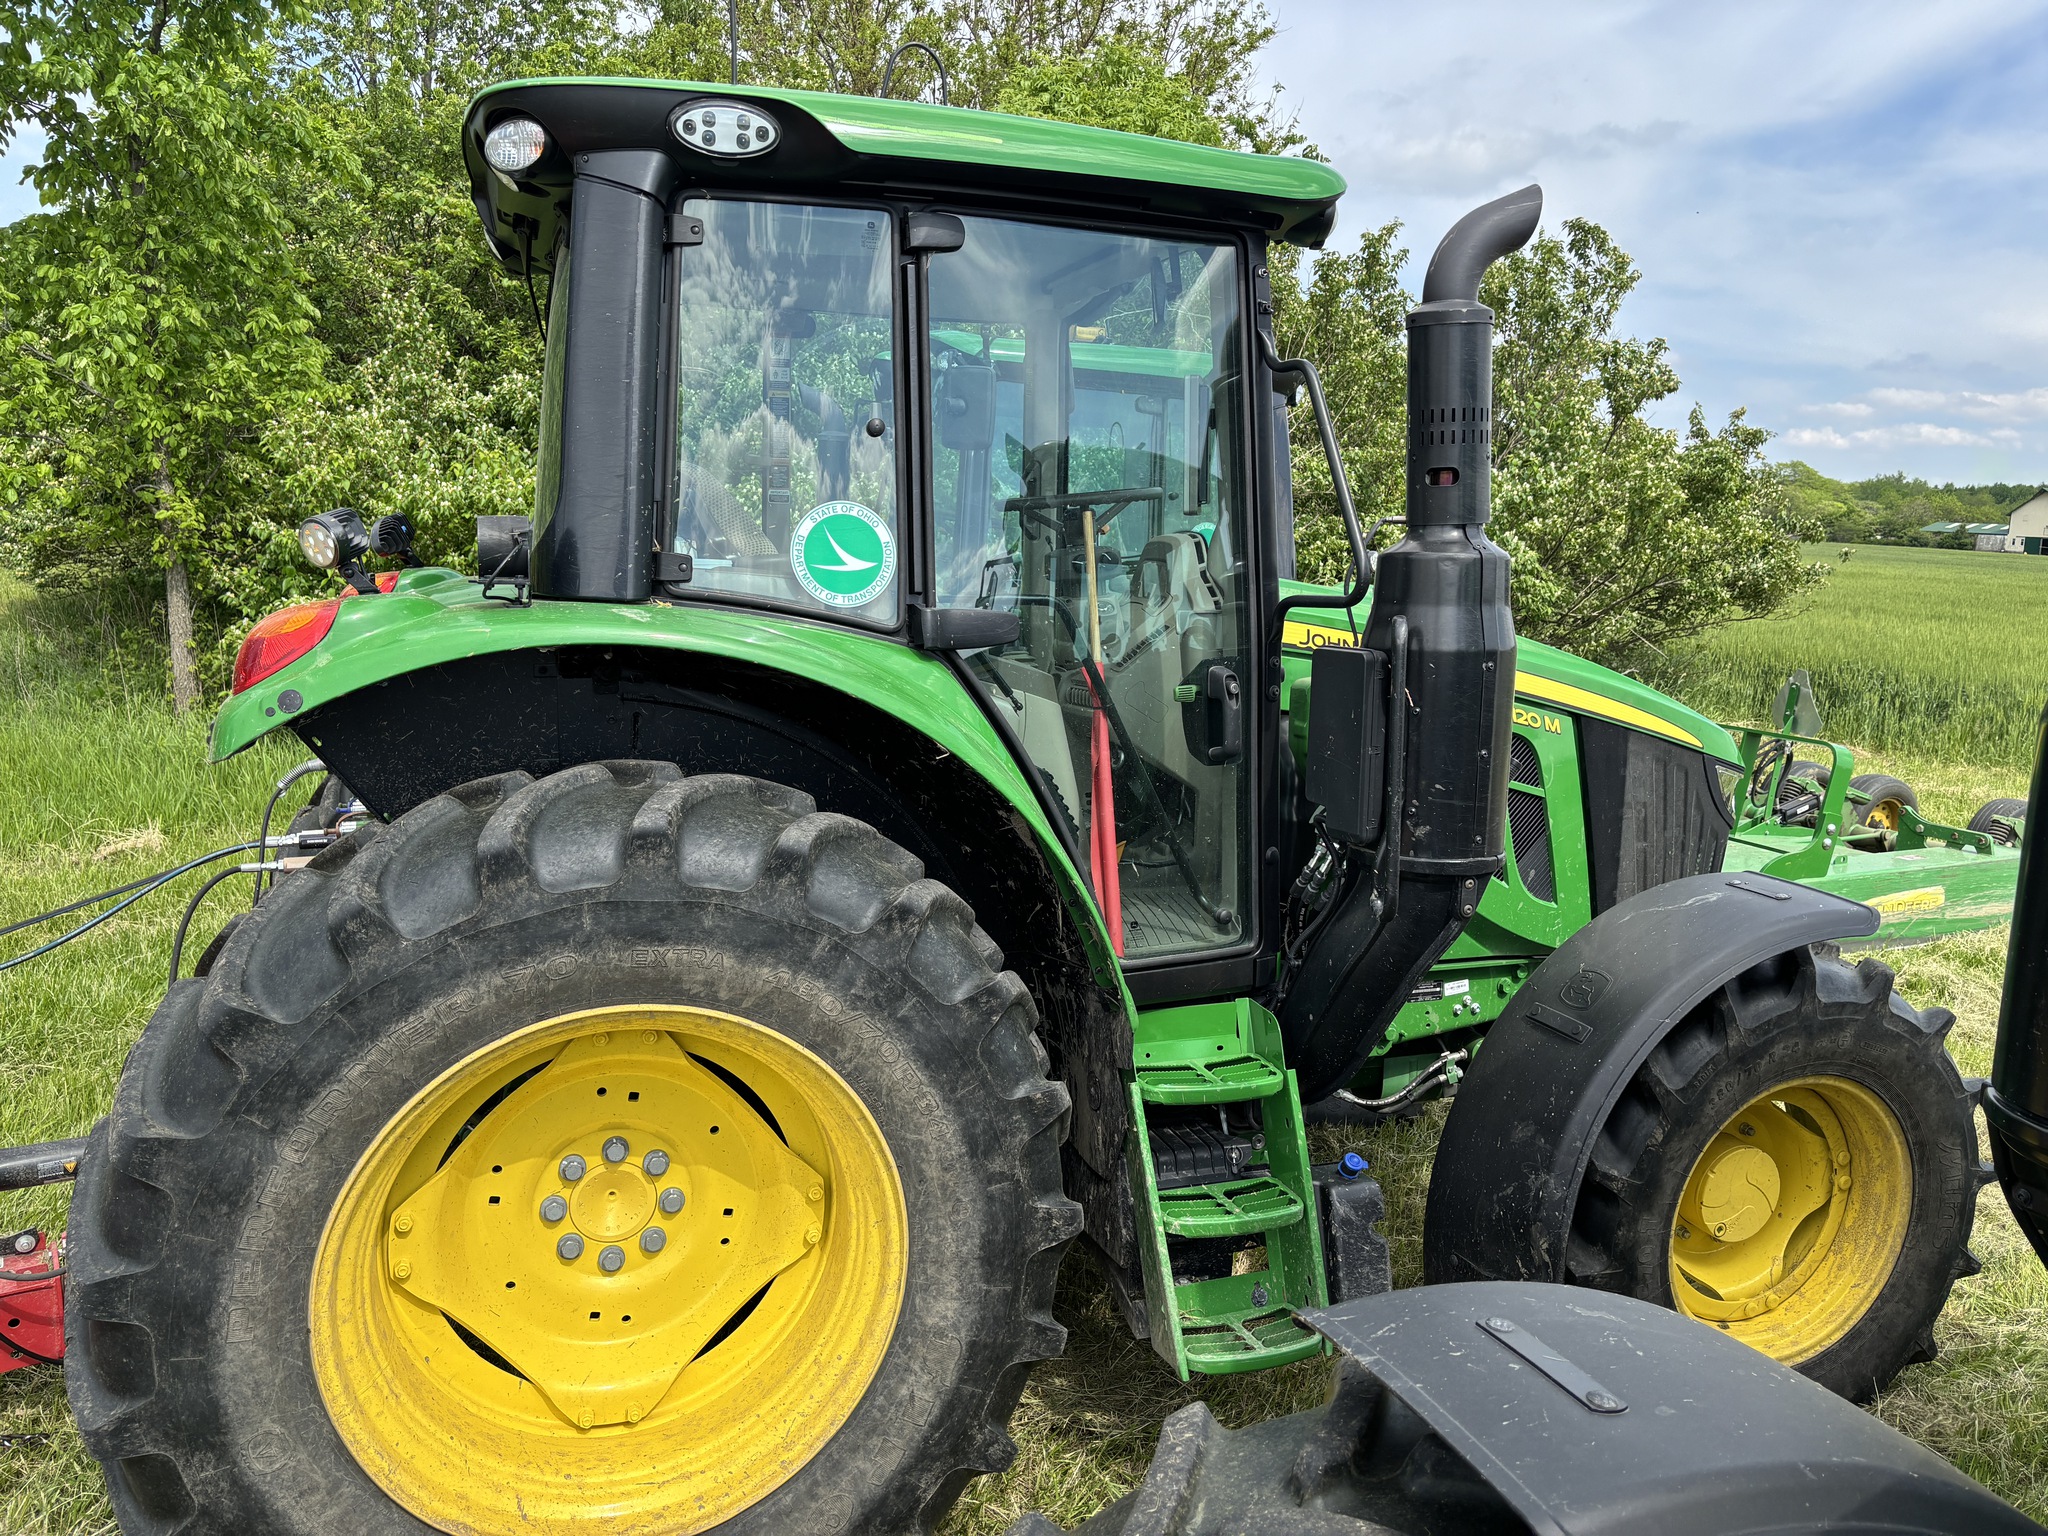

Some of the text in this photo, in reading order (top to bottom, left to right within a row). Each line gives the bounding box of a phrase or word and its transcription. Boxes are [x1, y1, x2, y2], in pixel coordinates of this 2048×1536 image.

[810, 505, 880, 529] STATE OF OHIO
[794, 534, 893, 604] DEPARTMENT OF TRANSPORTATION
[1299, 628, 1358, 649] JOHN
[1543, 714, 1561, 735] M
[502, 951, 581, 995] 70
[630, 948, 725, 972] EXTRA
